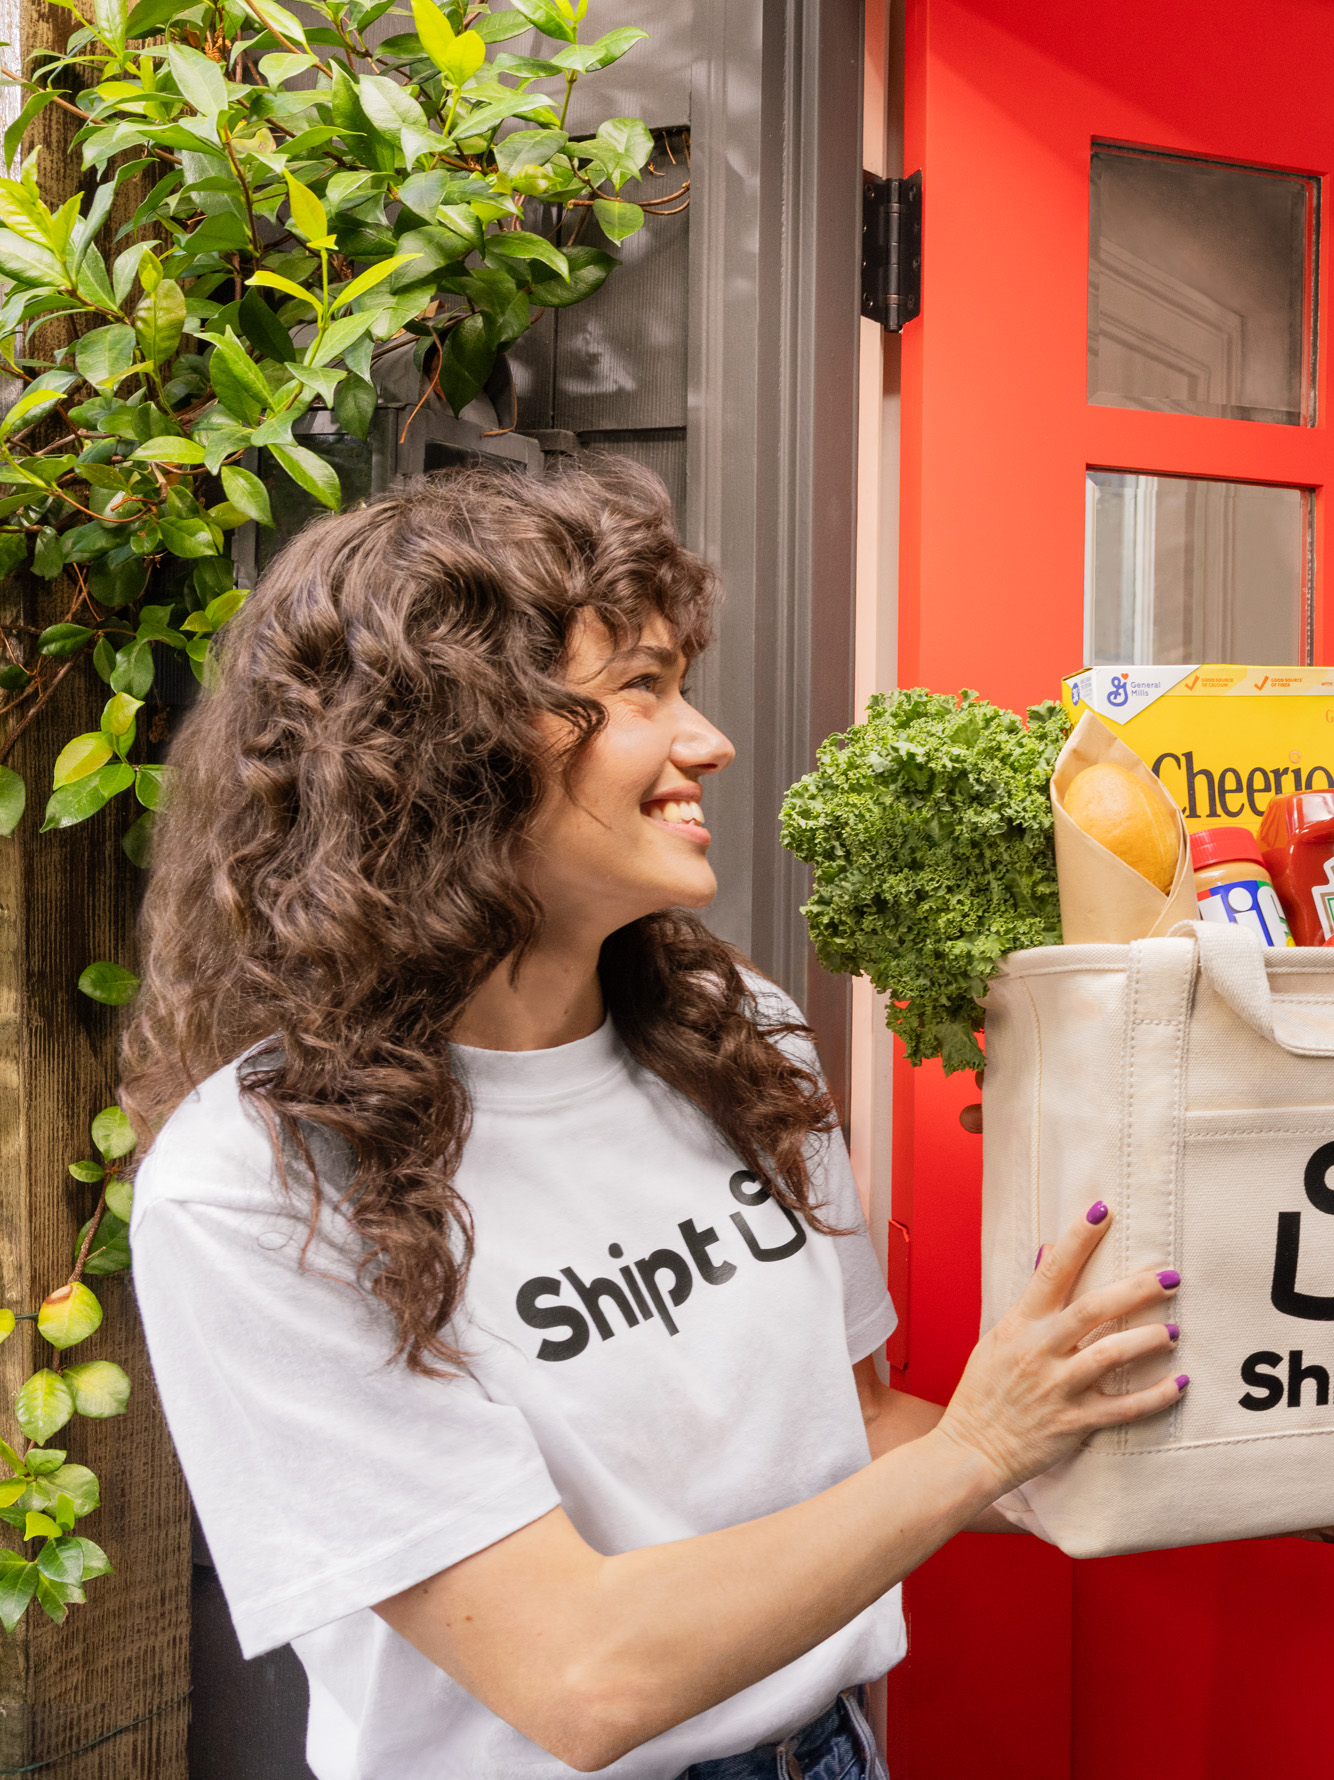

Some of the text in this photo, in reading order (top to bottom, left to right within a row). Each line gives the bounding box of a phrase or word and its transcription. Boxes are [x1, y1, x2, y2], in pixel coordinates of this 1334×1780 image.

[1130, 681, 1161, 689] General
[1131, 689, 1149, 697] Mills
[515, 1217, 738, 1362] Shipt
